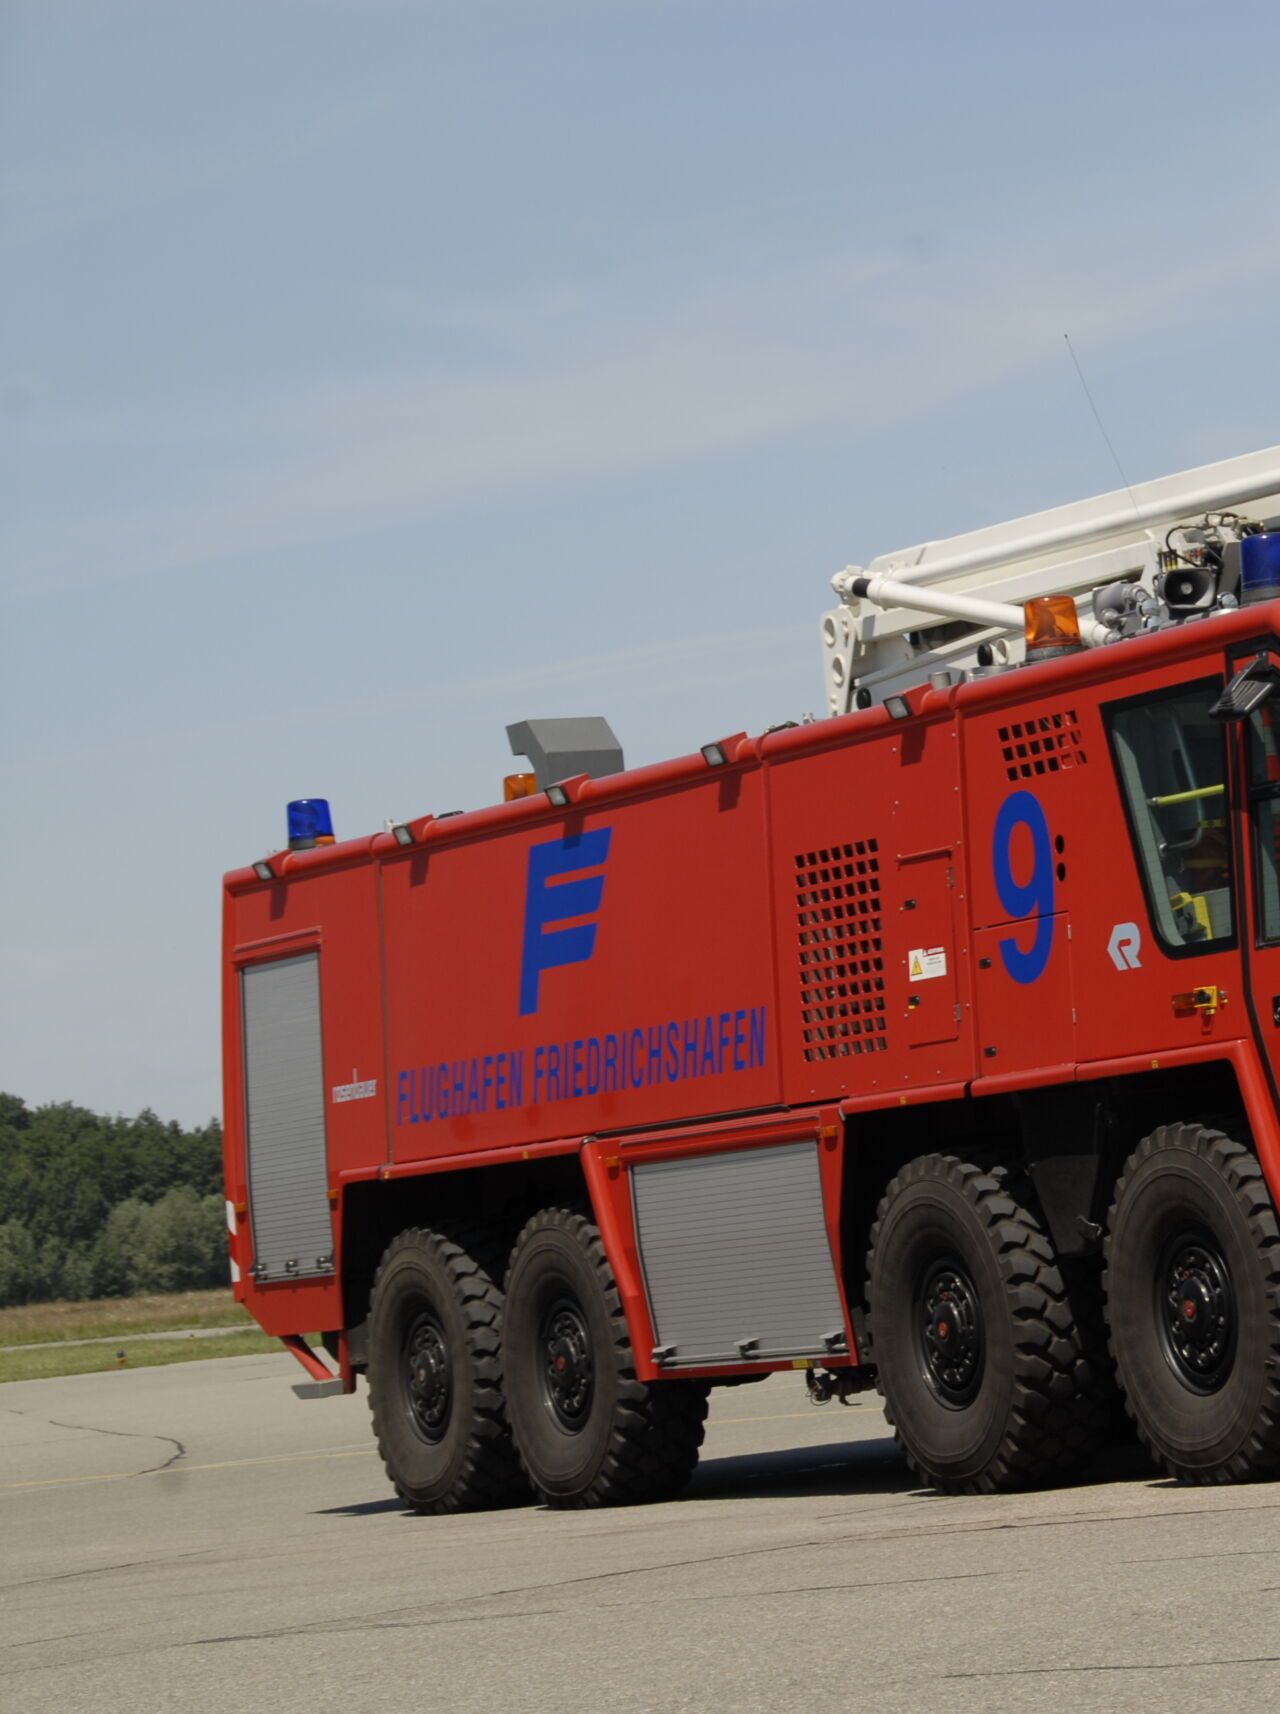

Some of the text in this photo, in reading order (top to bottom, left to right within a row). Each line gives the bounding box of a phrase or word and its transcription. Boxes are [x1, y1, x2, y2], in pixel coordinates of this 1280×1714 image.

[992, 790, 1055, 984] 9
[397, 1005, 767, 1127] FLUGHAFEN FRIEDRICHSHAFEN
